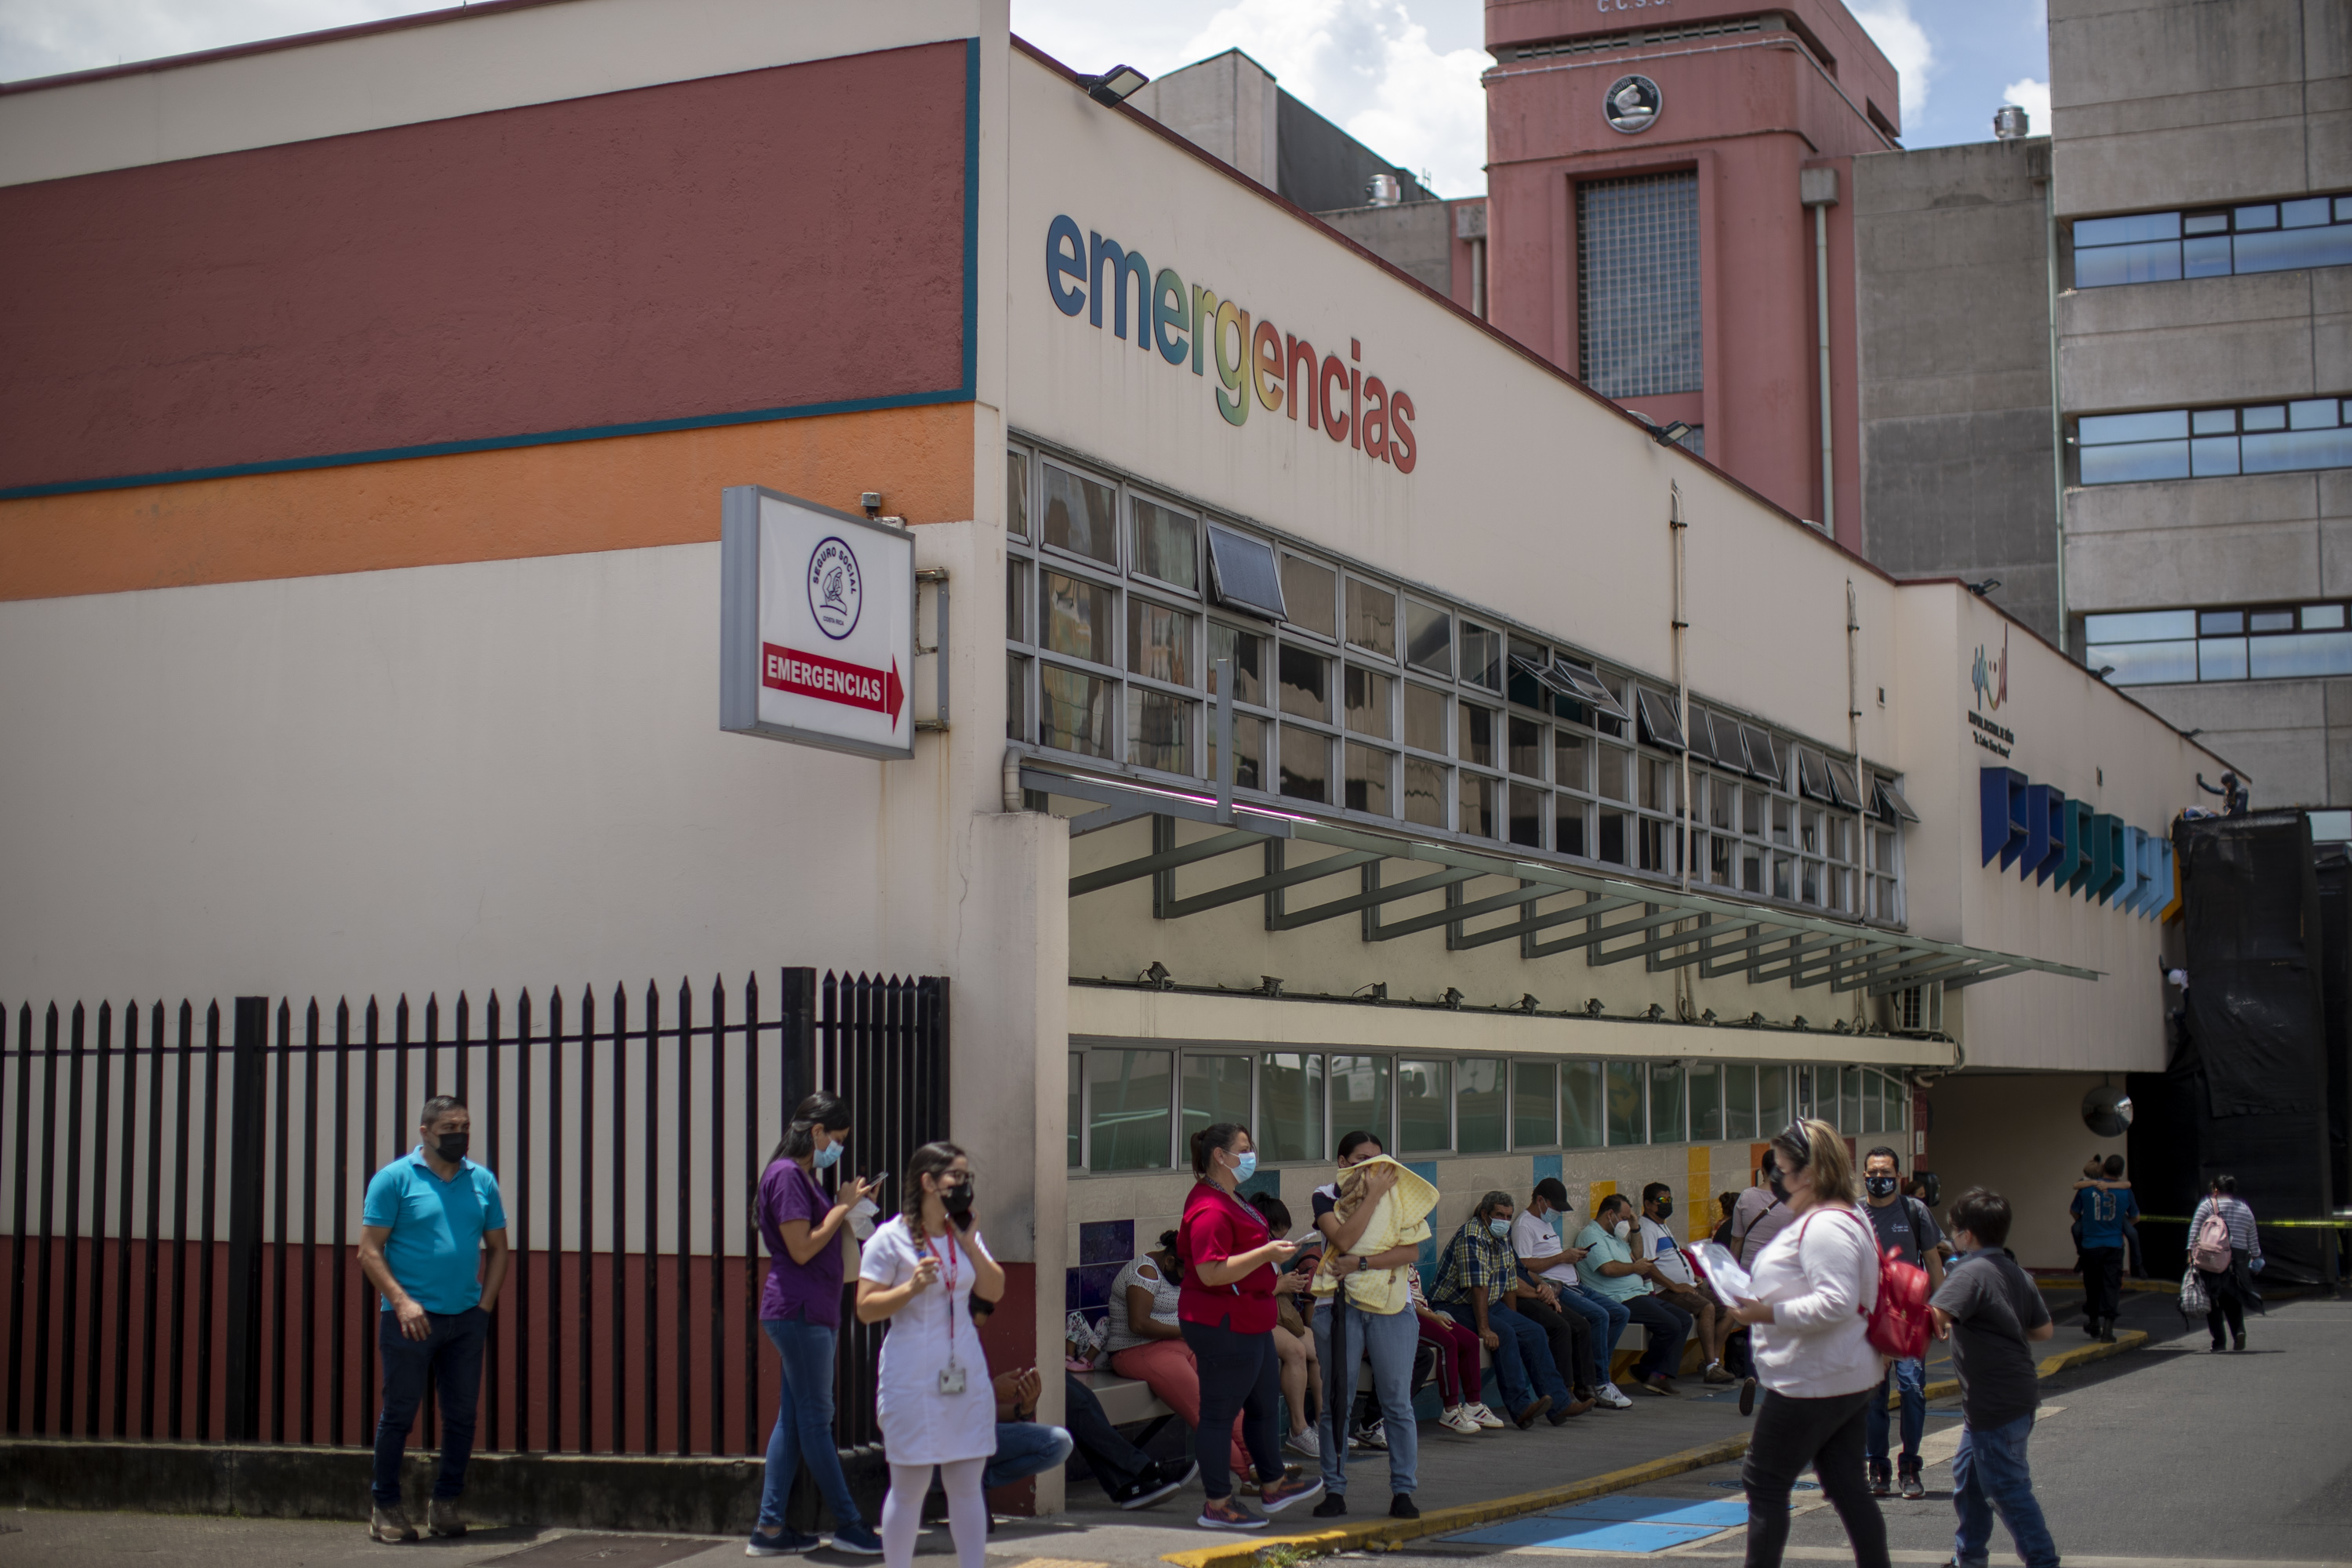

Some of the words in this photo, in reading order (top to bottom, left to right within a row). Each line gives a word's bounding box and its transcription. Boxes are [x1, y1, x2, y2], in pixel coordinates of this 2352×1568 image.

[1046, 214, 1417, 474] emergencias
[813, 547, 837, 585] SEGURO
[838, 550, 857, 595] SOCIAL
[823, 615, 835, 624] COSTA
[768, 654, 881, 702] EMERGENCIAS
[2092, 1191, 2117, 1221] 13
